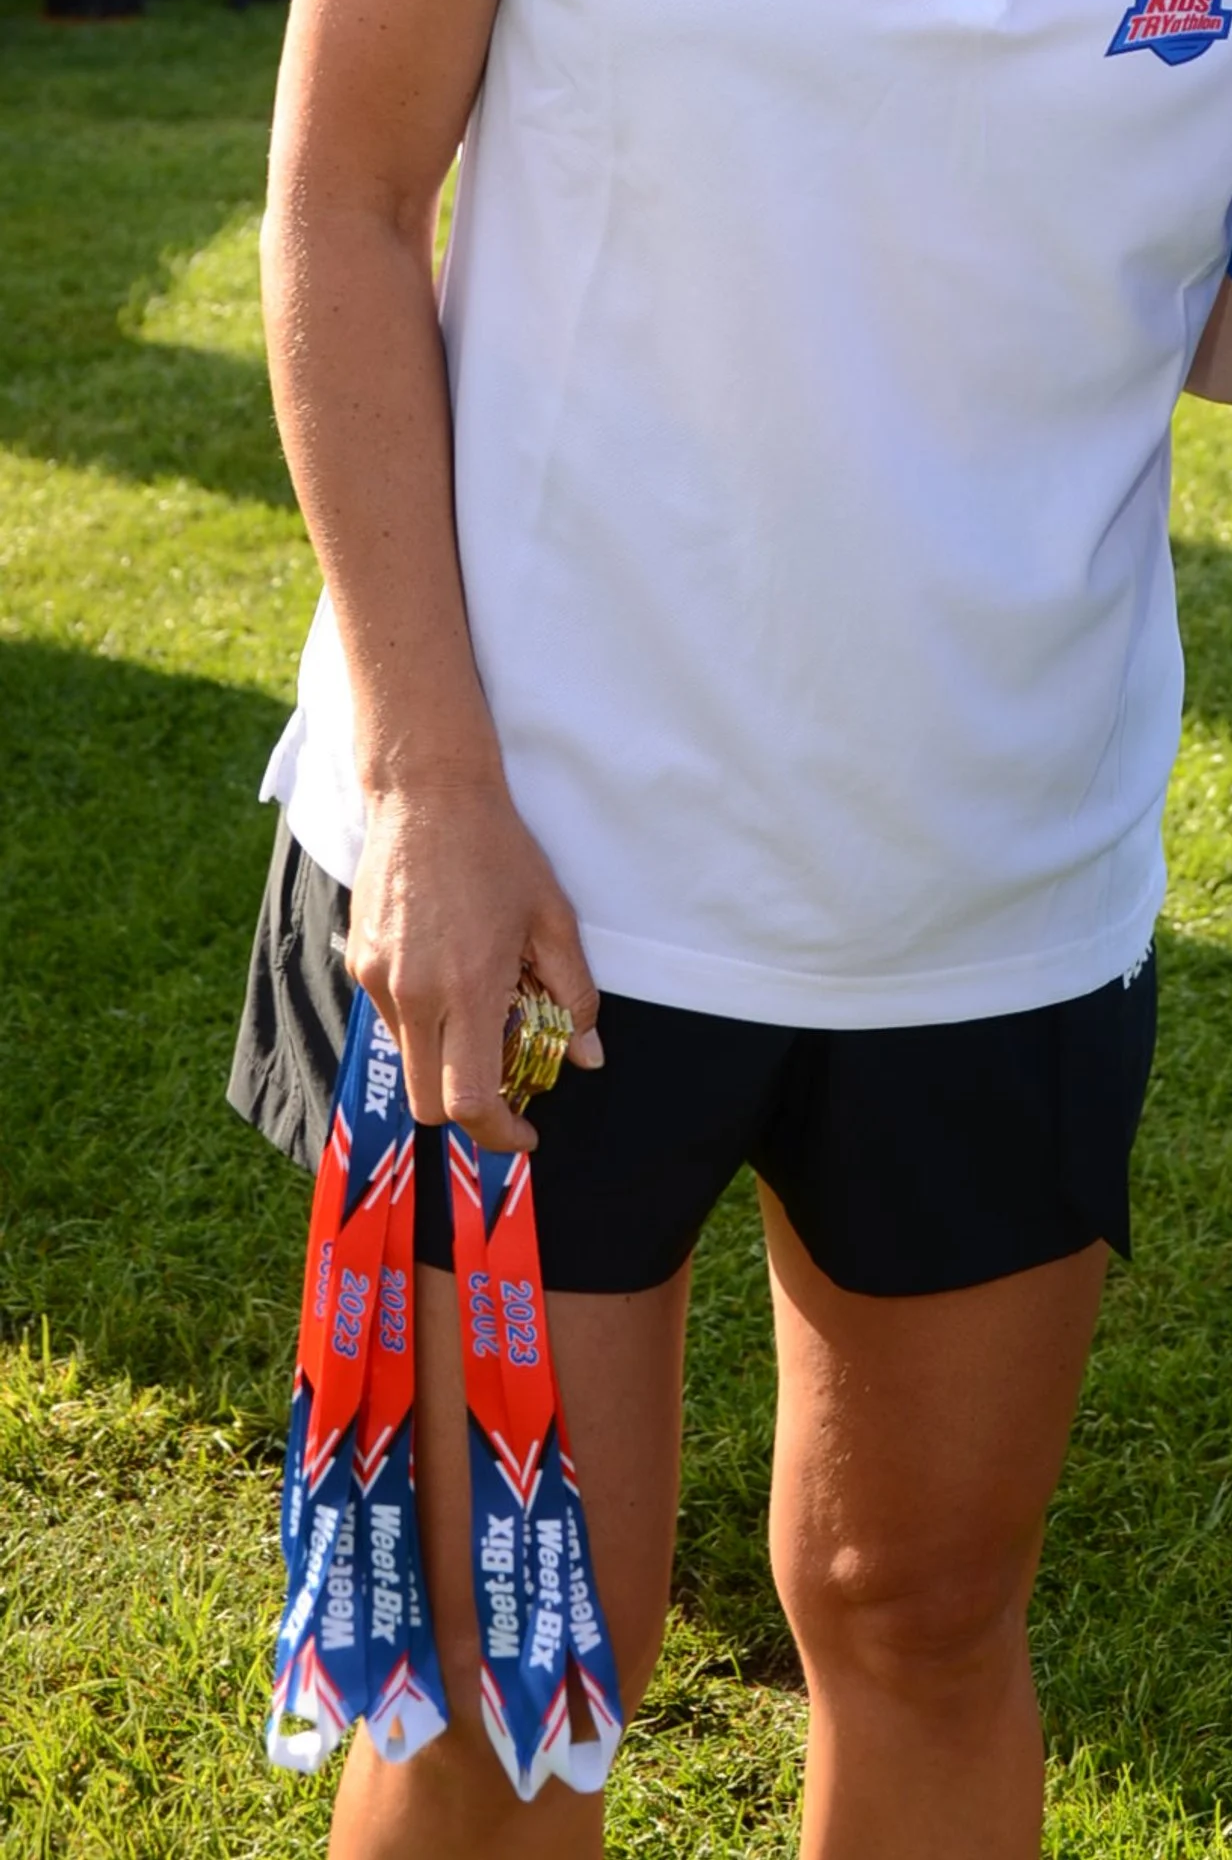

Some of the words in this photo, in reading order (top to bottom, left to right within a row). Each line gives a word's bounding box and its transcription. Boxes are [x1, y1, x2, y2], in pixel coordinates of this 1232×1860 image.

[1125, 13, 1224, 44] TRYathlon
[364, 1017, 400, 1122] et-Bix
[333, 1268, 370, 1360] 2023
[380, 1265, 407, 1354] 2023
[500, 1280, 540, 1367] 2023
[370, 1504, 403, 1645] Weet-Bix
[481, 1513, 520, 1659] Weet-Bix
[529, 1519, 564, 1673] Weet-Bix
